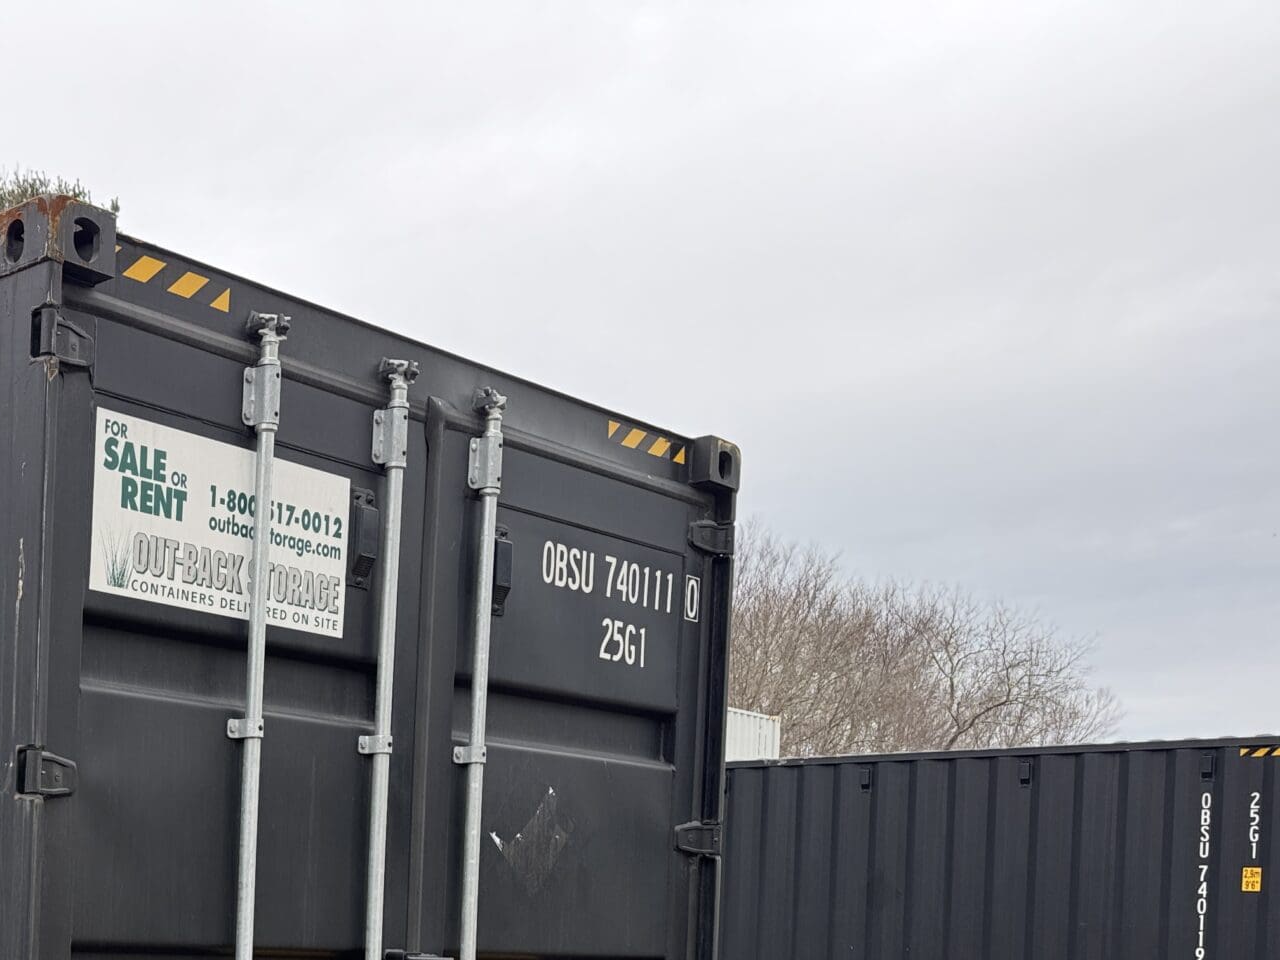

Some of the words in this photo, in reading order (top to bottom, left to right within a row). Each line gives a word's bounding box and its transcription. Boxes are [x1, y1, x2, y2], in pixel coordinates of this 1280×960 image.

[104, 419, 128, 439] FOR
[103, 437, 167, 483] SALE
[171, 471, 188, 488] OR
[121, 476, 188, 522] RENT
[209, 514, 341, 560] outbactorage.com
[133, 531, 244, 595] OUT-BACK
[542, 540, 595, 594] OBSU
[605, 555, 673, 614] 740111
[131, 579, 214, 607] CONTAINERS
[220, 597, 287, 621] DELIRED
[292, 612, 309, 626] ON
[314, 616, 339, 631] SITE
[599, 617, 646, 668] 25G1
[1249, 792, 1261, 859] 25G1
